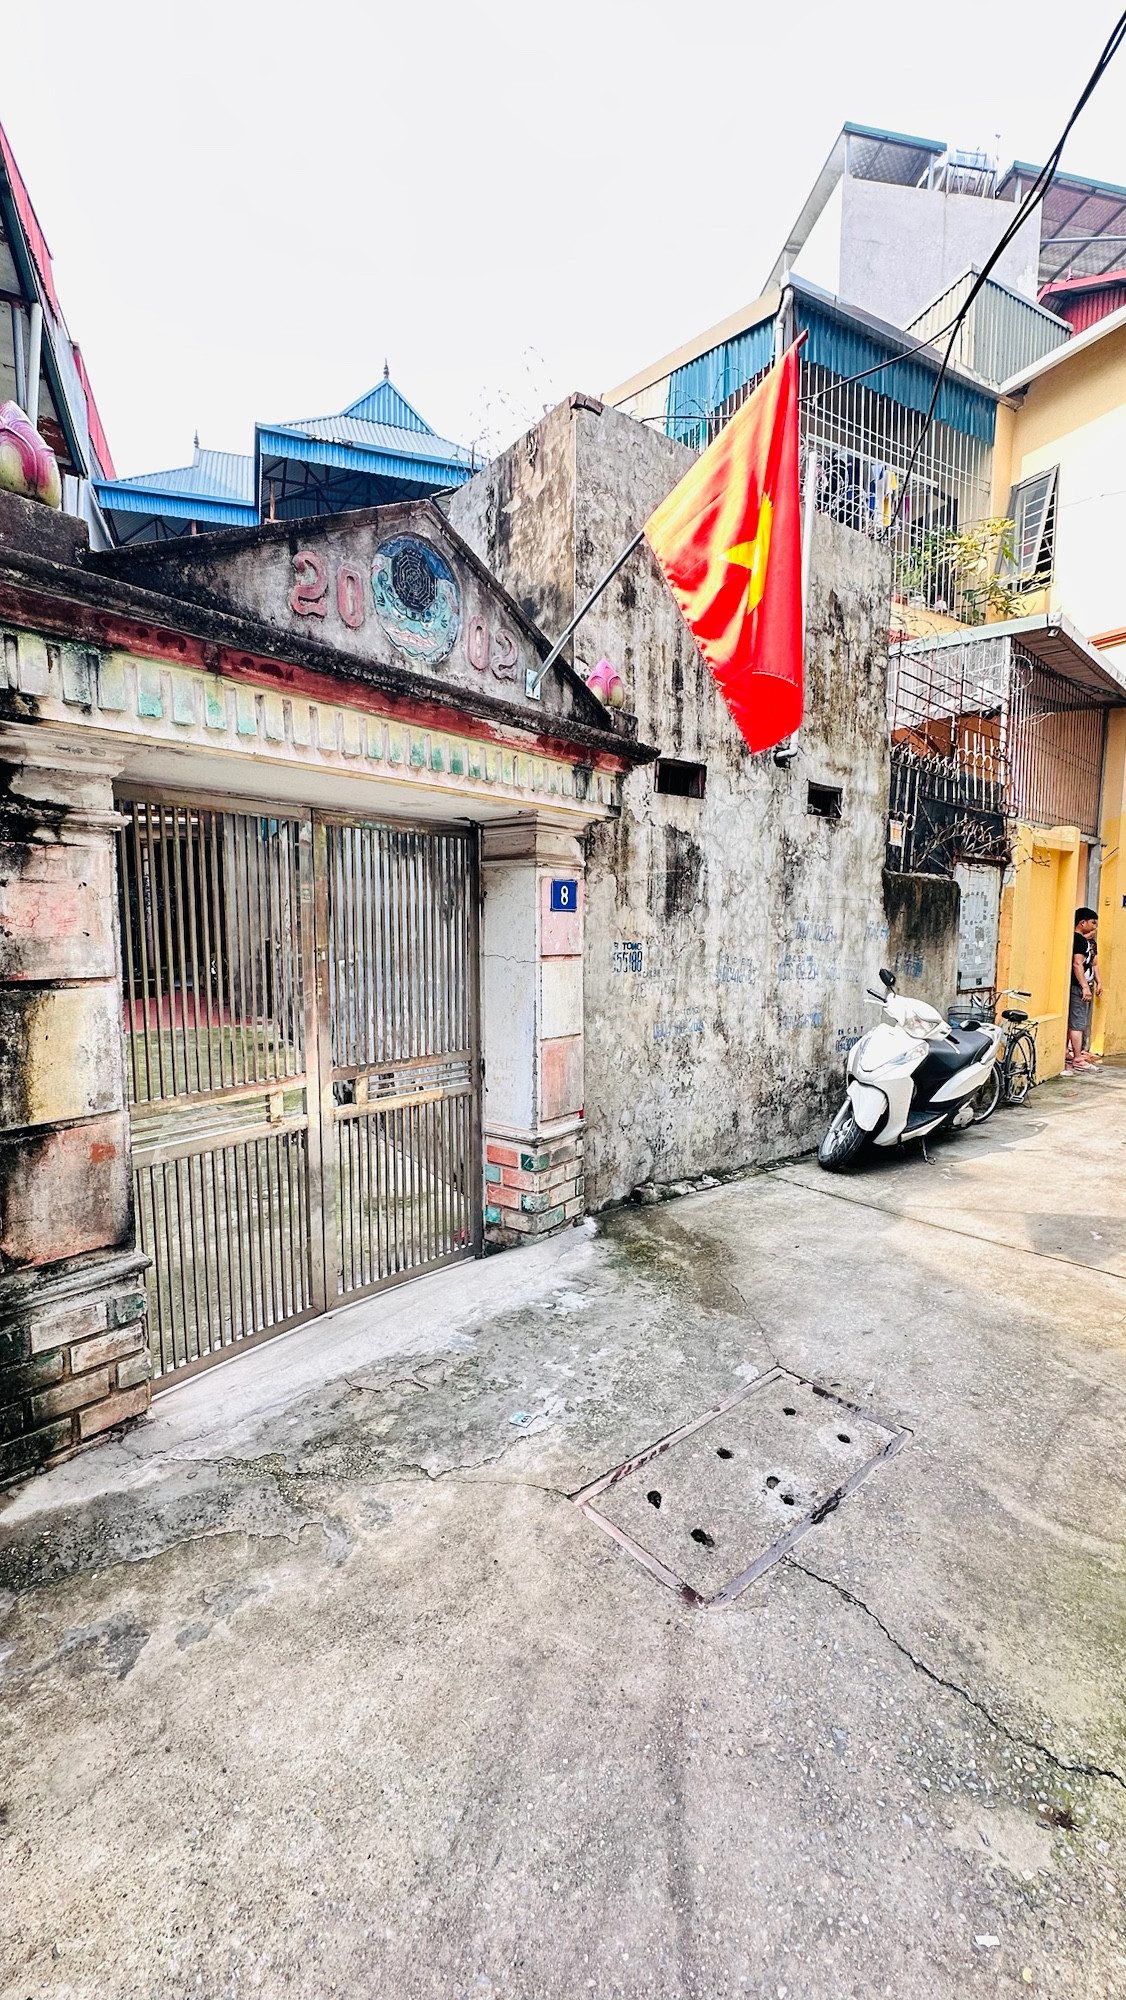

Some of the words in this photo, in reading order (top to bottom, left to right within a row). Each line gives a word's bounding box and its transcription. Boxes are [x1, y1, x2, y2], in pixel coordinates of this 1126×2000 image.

[290, 550, 365, 629] 20
[468, 614, 519, 682] 02
[560, 885, 569, 906] 8
